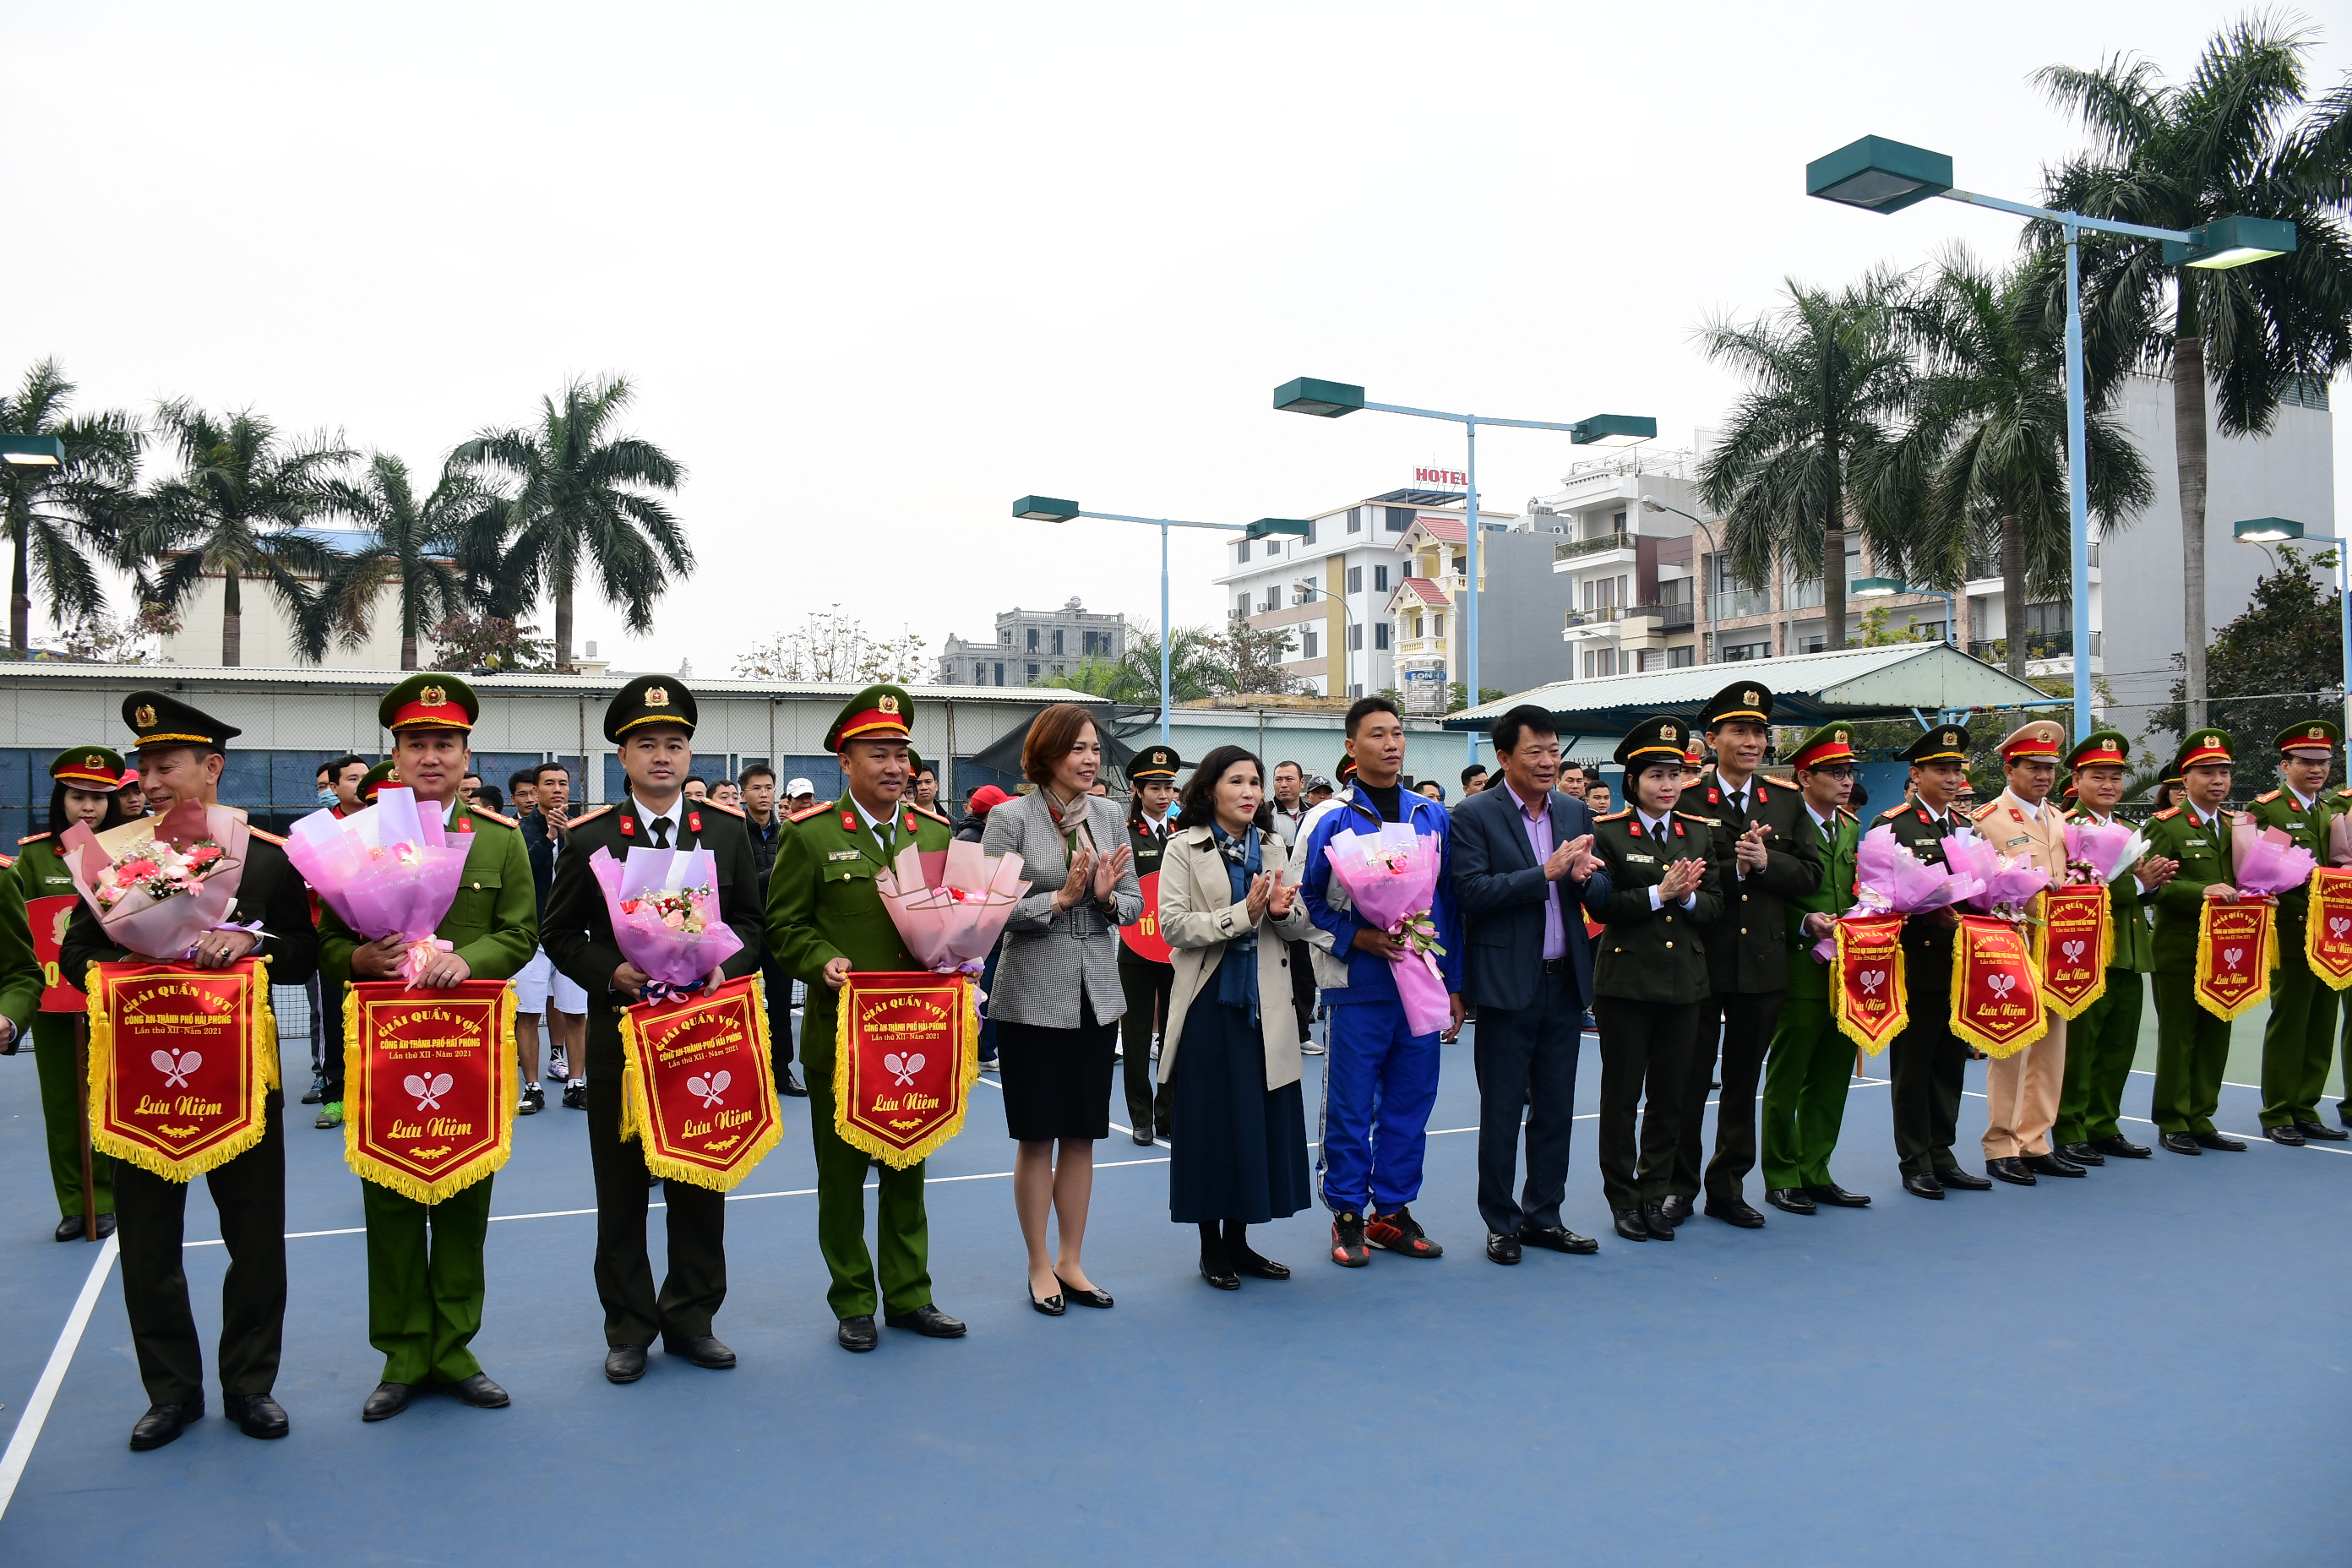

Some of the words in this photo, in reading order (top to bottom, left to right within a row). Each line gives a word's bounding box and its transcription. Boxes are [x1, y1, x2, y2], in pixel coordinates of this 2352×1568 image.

[1416, 468, 1468, 485] HOTEL
[1139, 911, 1155, 935] TỔ
[122, 989, 155, 1013] GIẢI
[158, 982, 200, 997] QUẦN
[204, 990, 233, 1012] VỢT
[124, 1014, 144, 1025] CÔNG
[145, 1015, 155, 1024] AN
[180, 1011, 193, 1025] PHỐ
[194, 1011, 207, 1025] HẢI
[208, 1011, 231, 1025] PHÒNG
[378, 1015, 409, 1037] GIẢI
[411, 1006, 451, 1023] QUẦN
[455, 1015, 482, 1035] VỢT
[925, 1001, 948, 1020] VỢT
[2000, 1003, 2027, 1020] Niệm
[656, 1026, 680, 1052] GIẢI
[718, 1015, 741, 1030] VỢT
[864, 1022, 879, 1032] CÔNG
[380, 1038, 398, 1049] CÔNG
[399, 1039, 409, 1049] AN
[432, 1036, 445, 1048] PHỐ
[446, 1035, 457, 1048] HẢI
[458, 1036, 481, 1048] PHÒNG
[659, 1050, 675, 1063] CÔNG
[703, 1037, 716, 1050] PHỐ
[725, 1044, 739, 1054] 2021
[134, 1094, 171, 1115] Lưu
[174, 1096, 223, 1121] Niệm
[872, 1093, 899, 1112] Lưu
[902, 1092, 939, 1114] Niệm
[387, 1119, 422, 1139] Lưu
[427, 1117, 472, 1141] Niệm
[681, 1119, 712, 1140] Lưu
[715, 1108, 754, 1130] Niệm
